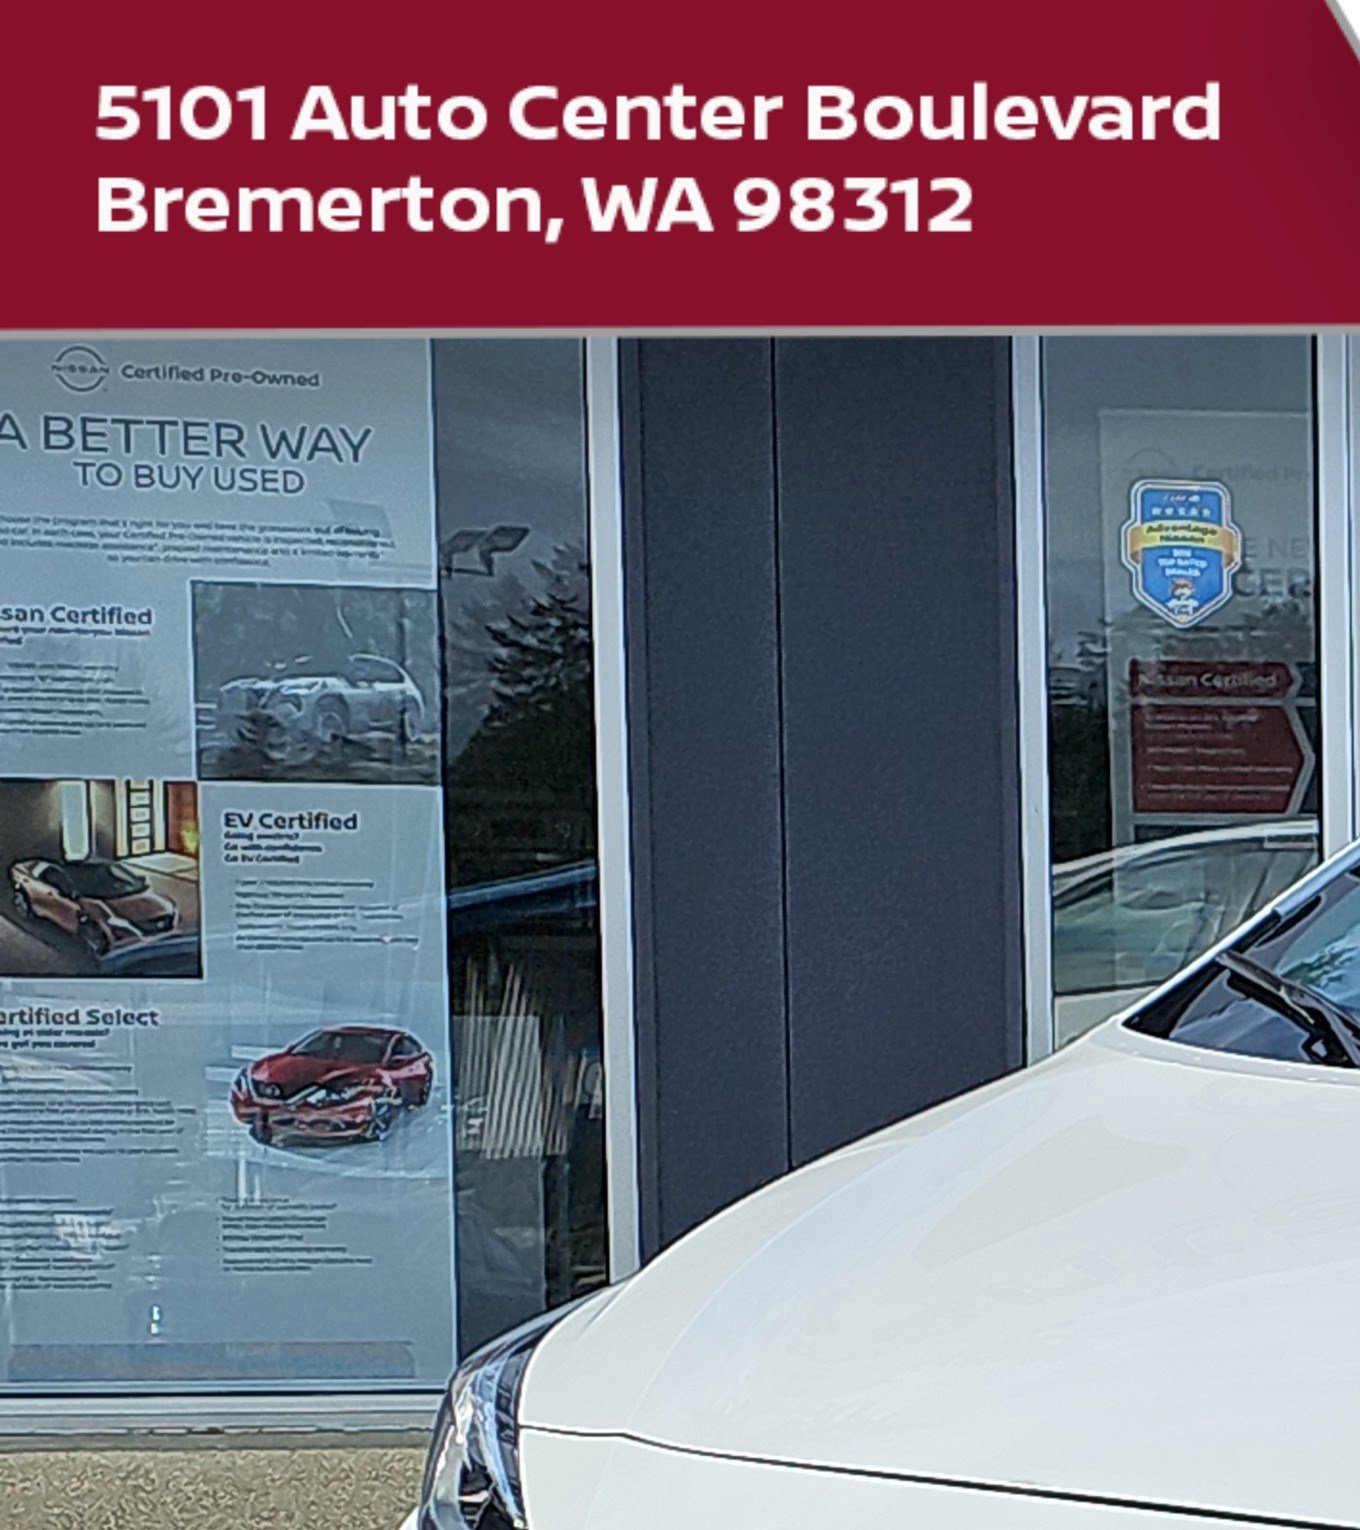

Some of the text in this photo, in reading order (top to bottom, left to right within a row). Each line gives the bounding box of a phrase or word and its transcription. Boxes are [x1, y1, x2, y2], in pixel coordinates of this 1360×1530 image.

[121, 364, 320, 387] Certified Pre-Owned
[0, 413, 372, 463] A BETTER WAY
[73, 461, 305, 493] TO BUY USED
[52, 606, 152, 625] Certified
[1137, 674, 1277, 687] Nissan Certified
[224, 813, 357, 829] EV Certified
[0, 1008, 158, 1026] ertified Select
